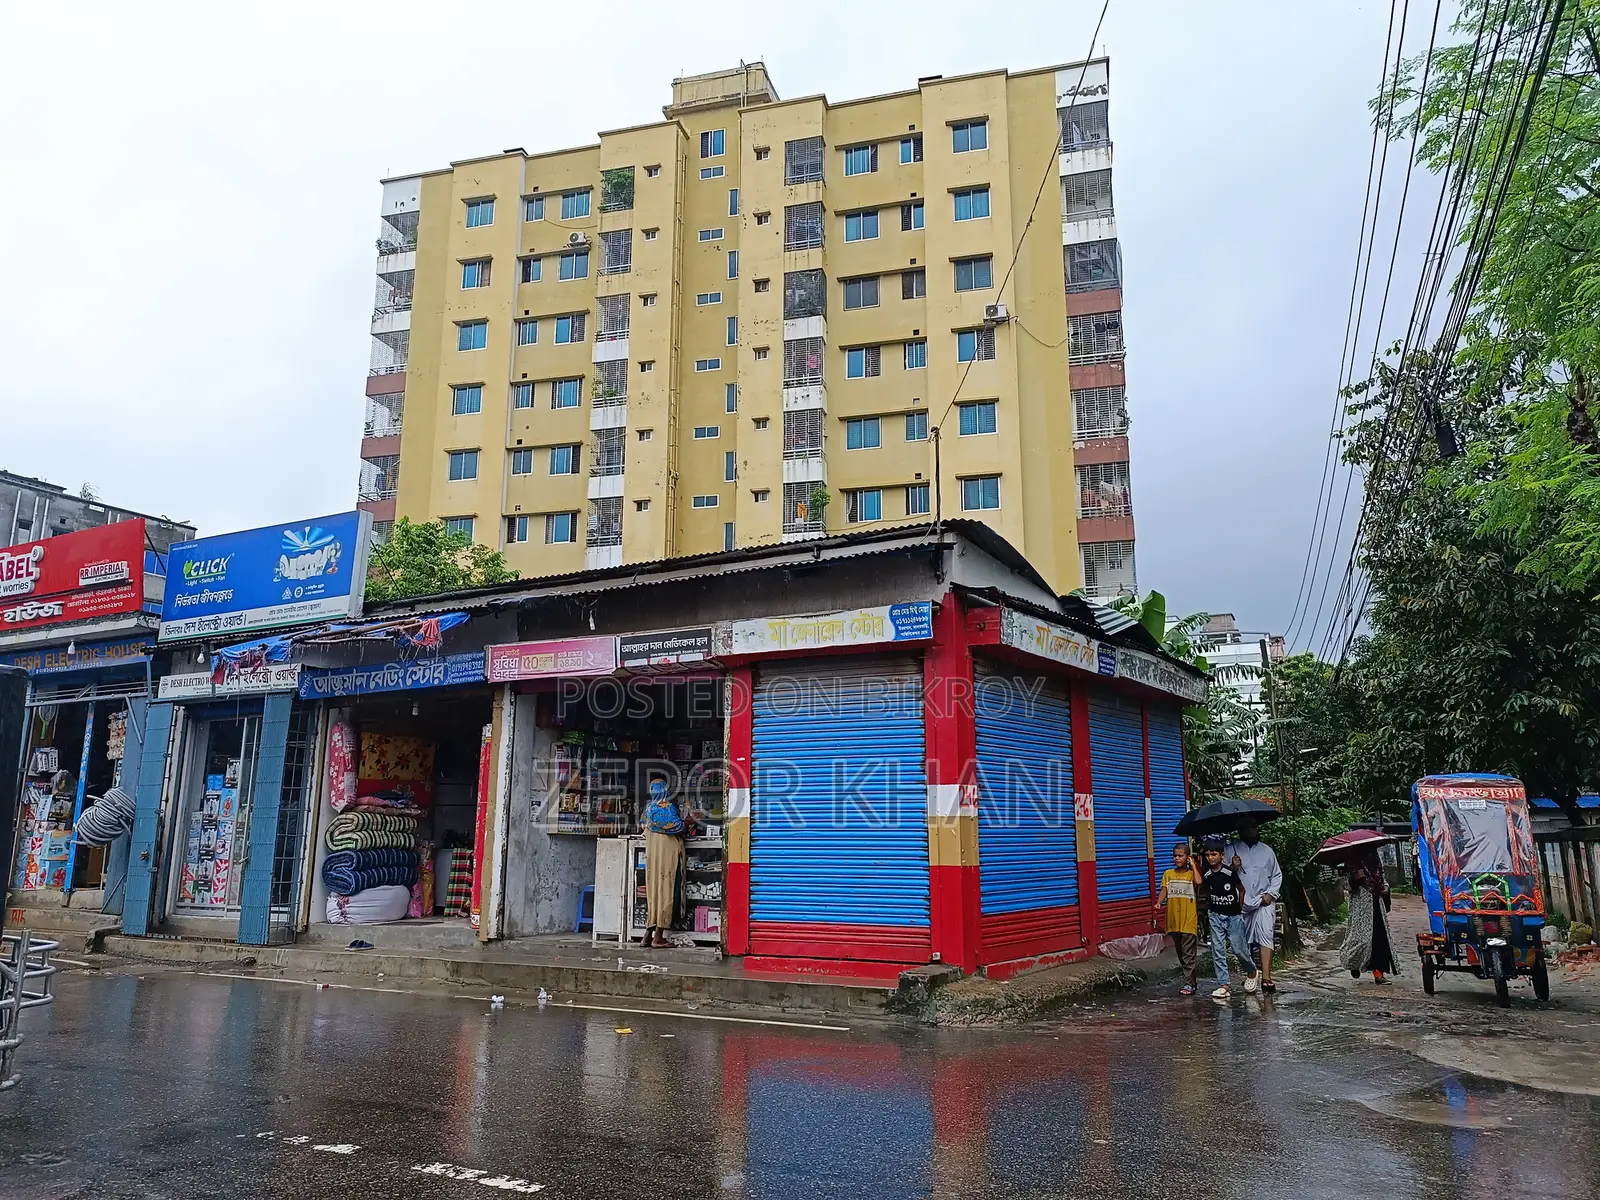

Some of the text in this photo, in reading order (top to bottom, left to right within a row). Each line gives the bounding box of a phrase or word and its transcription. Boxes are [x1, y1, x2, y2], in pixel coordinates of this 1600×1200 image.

[80, 562, 124, 579] RR IMPERIAL
[190, 553, 235, 576] CLICK
[3, 580, 29, 593] worries
[3, 601, 65, 622] হাউজ
[621, 642, 650, 654] আল্লাহর
[650, 641, 663, 650] দান
[663, 636, 696, 649] মেডিকেল
[695, 636, 709, 646] হল
[15, 642, 146, 671] DESH ELECTRIC HOUSE
[493, 655, 520, 670] সুবিধা
[522, 656, 539, 669] ৫০
[170, 678, 183, 688] DESH
[183, 676, 205, 688] ELECTRO
[369, 662, 405, 689] বেডিং
[405, 659, 449, 686] স্টোর
